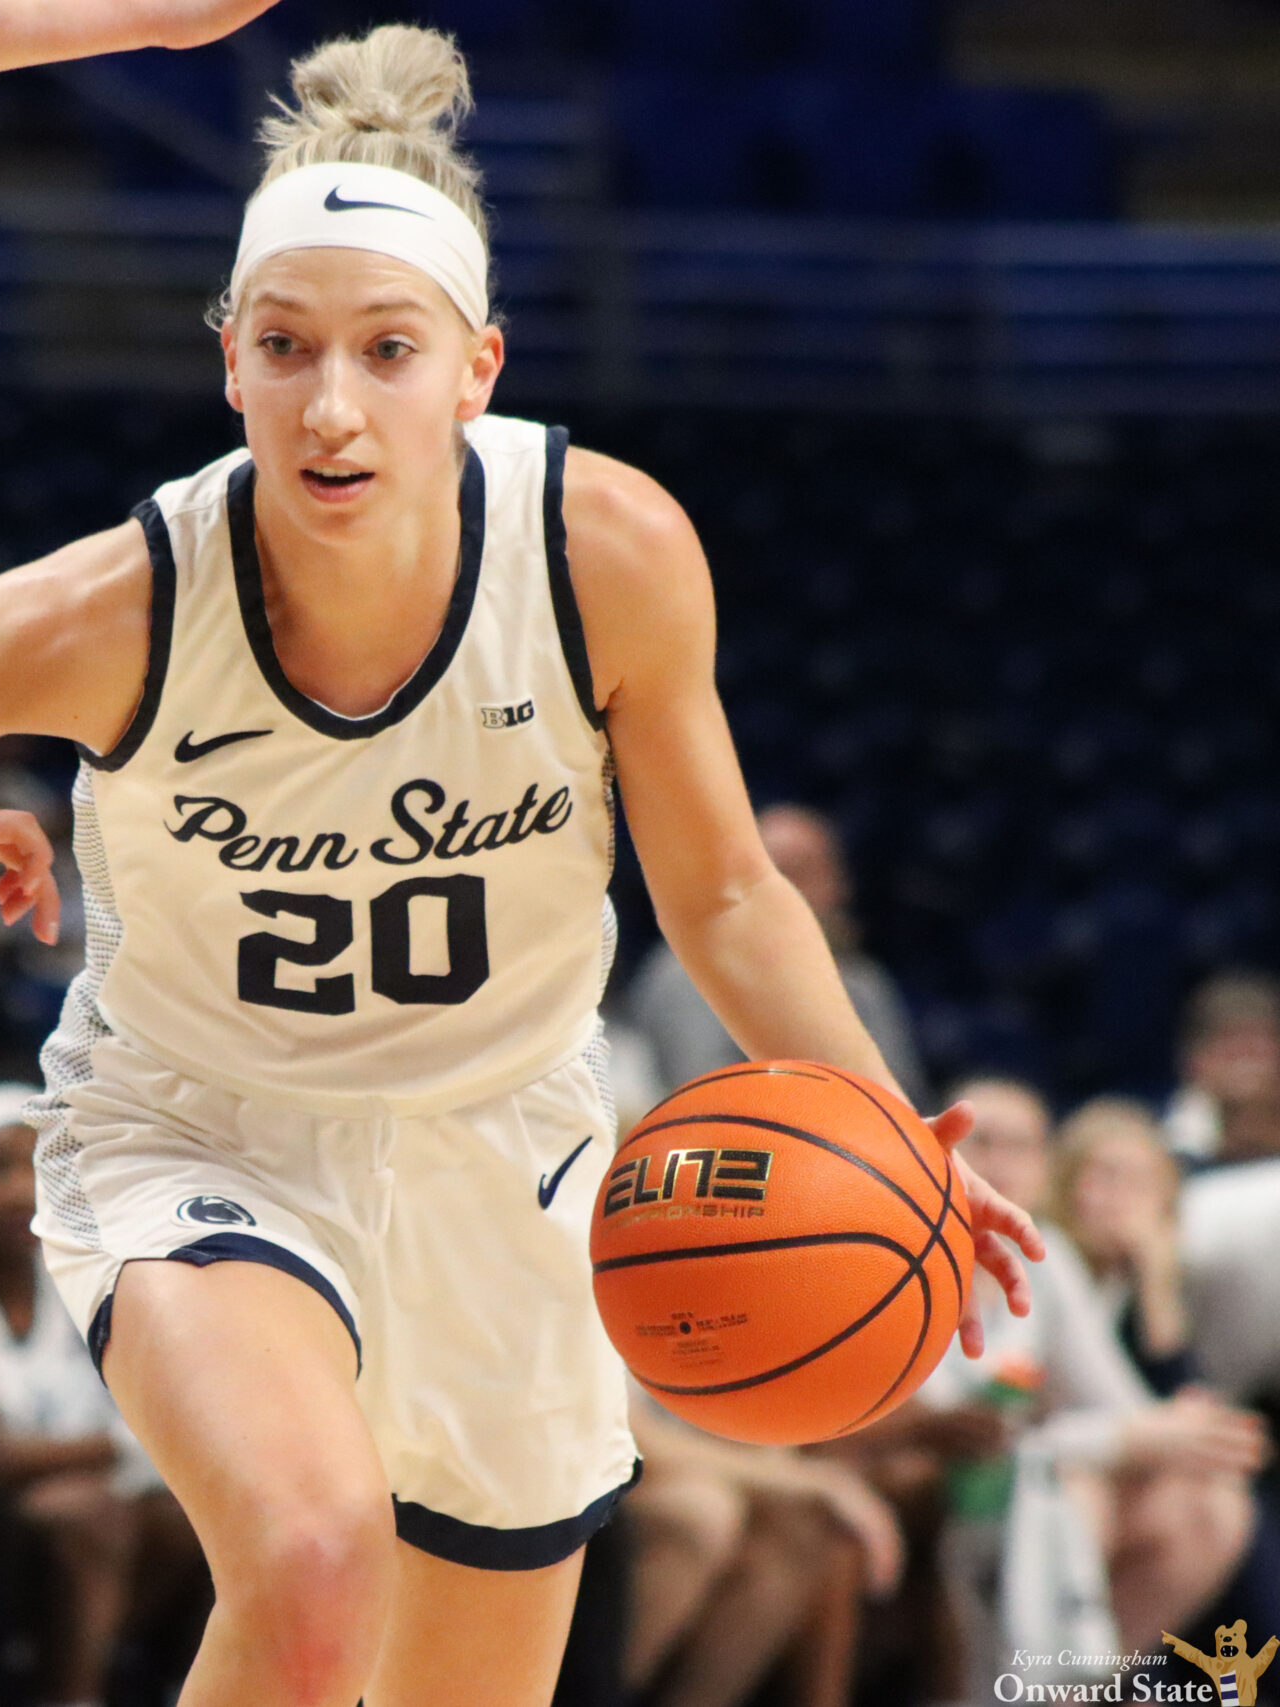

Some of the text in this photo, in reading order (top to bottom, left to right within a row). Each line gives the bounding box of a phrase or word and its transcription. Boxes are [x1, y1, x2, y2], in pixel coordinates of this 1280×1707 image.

[163, 778, 573, 872] Penn State
[237, 873, 490, 1016] 20
[604, 1148, 773, 1218] ELITE
